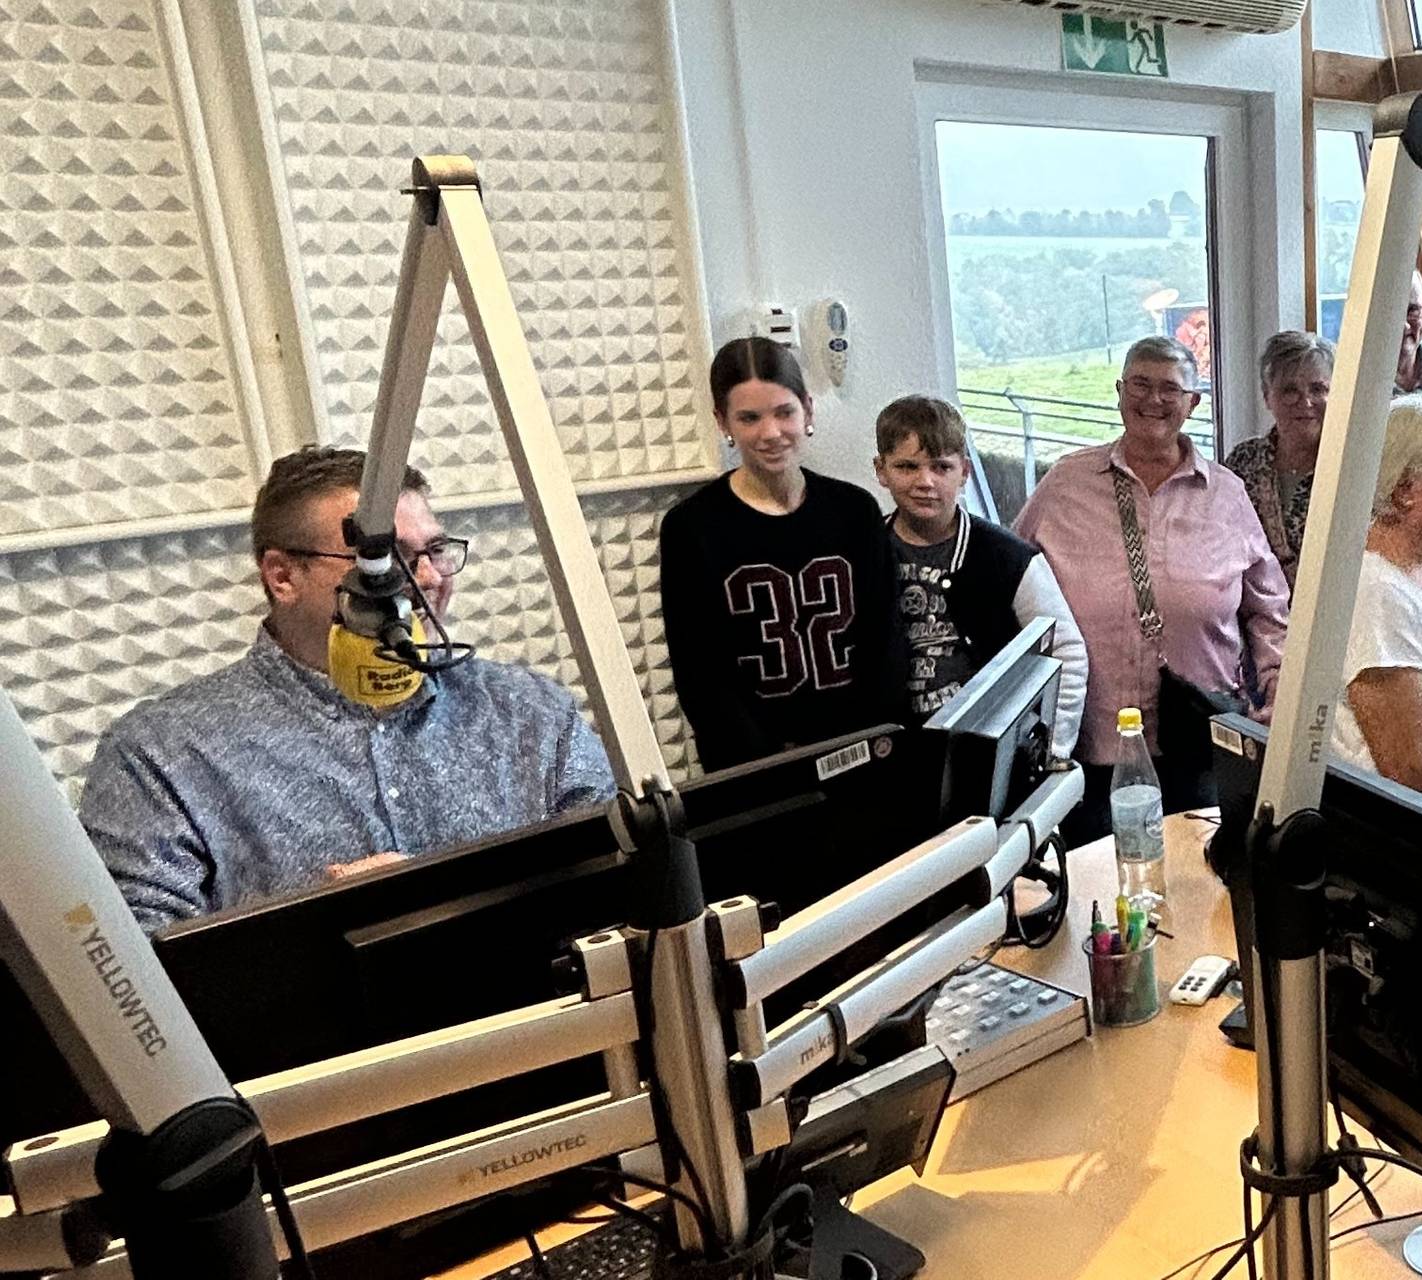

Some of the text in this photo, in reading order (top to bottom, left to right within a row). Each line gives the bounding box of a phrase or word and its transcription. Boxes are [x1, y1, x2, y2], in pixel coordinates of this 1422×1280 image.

[724, 555, 855, 698] 32
[81, 927, 167, 1057] YELLOWTEC
[478, 1134, 586, 1177] YELLOWTEC
